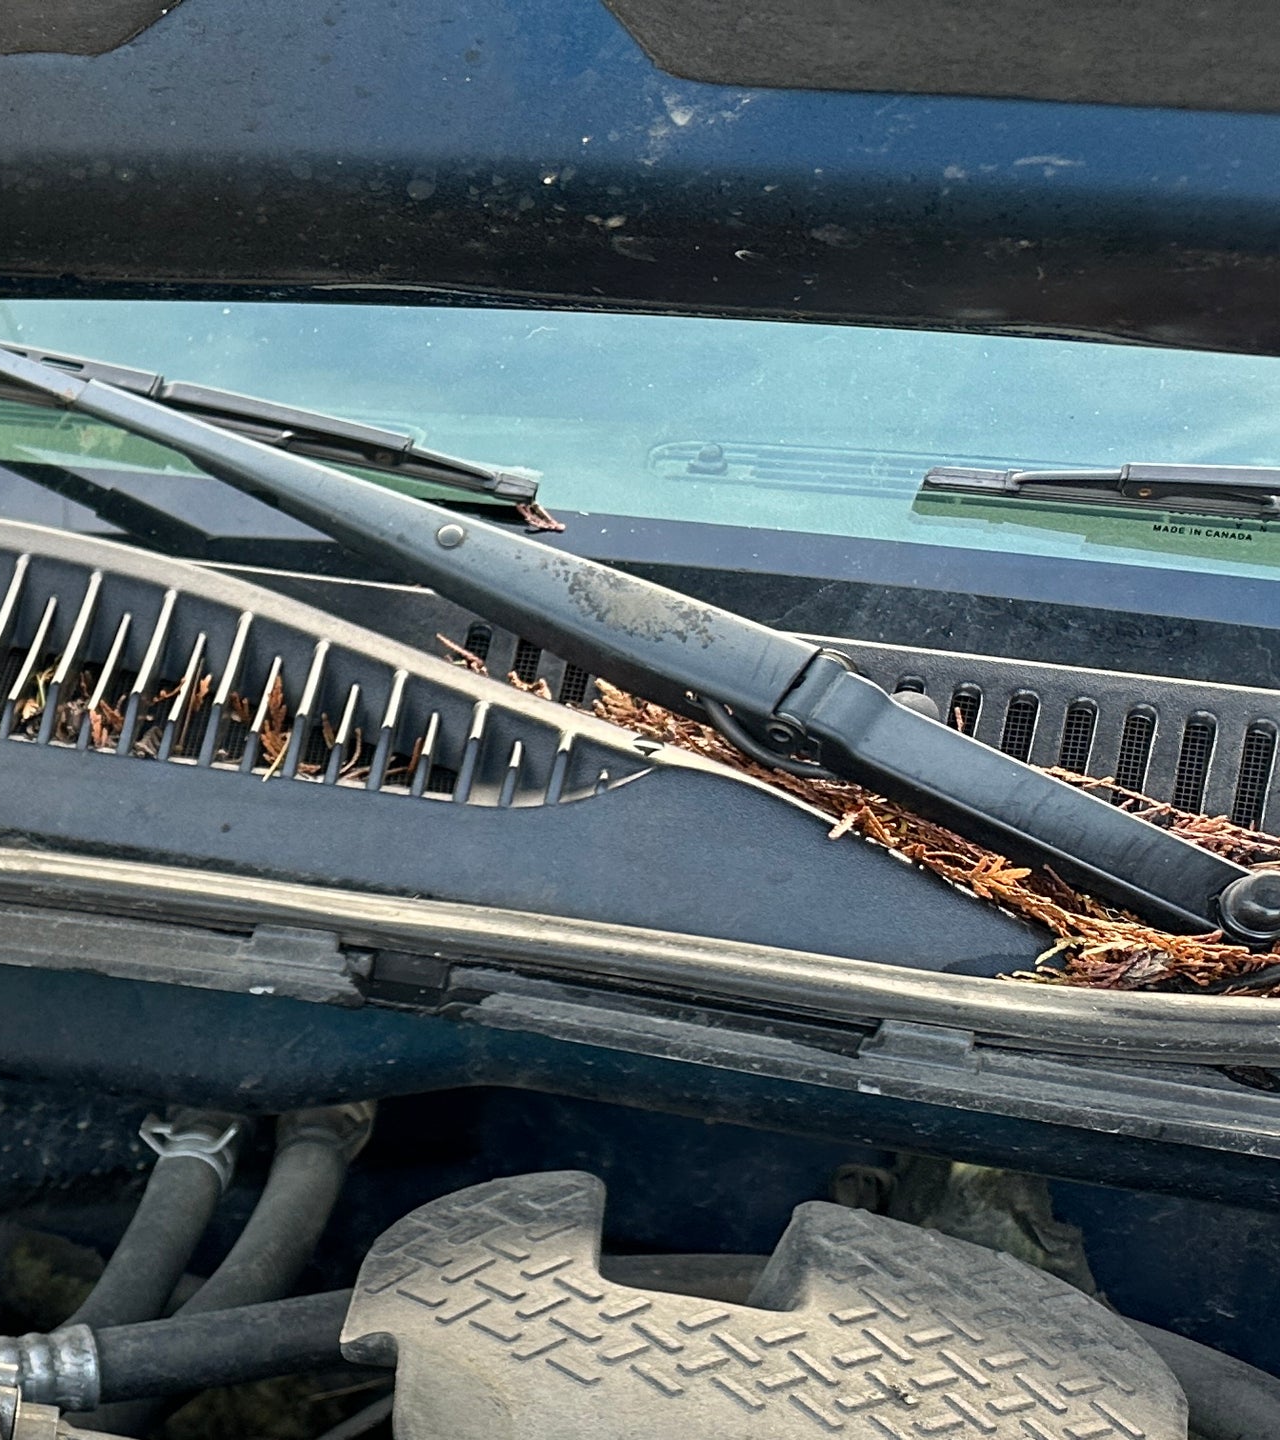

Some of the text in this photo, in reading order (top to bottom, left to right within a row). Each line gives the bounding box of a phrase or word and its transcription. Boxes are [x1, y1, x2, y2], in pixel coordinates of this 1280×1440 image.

[1153, 524, 1253, 541] MADE IN CANADA
